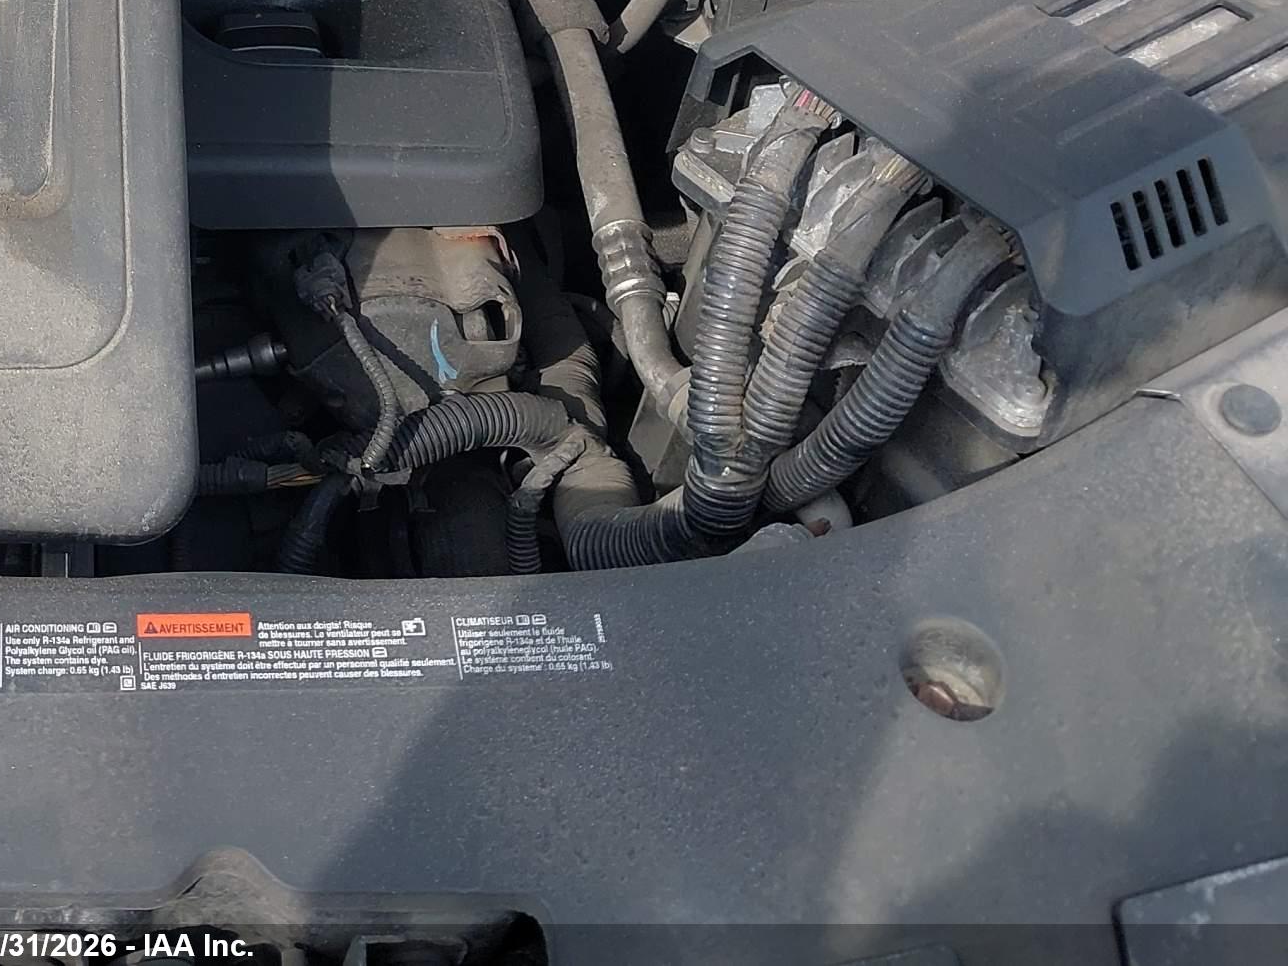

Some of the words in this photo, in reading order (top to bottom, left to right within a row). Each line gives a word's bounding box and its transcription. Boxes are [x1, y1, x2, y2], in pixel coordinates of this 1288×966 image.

[258, 621, 295, 630] Attention
[343, 620, 372, 631] Risque
[456, 617, 513, 626] CLIMATISEUR
[5, 625, 20, 633] AIR
[22, 624, 84, 633] CONDITIONING
[160, 623, 244, 634] AVERTISSEMENT
[258, 630, 268, 638] de
[271, 629, 313, 638] blessures.
[326, 629, 369, 637] ventilateur
[371, 628, 390, 638] peut
[488, 628, 530, 636] seulement
[5, 636, 21, 644] Use
[22, 636, 40, 646] only
[43, 636, 70, 644] R-134a
[73, 636, 118, 646] Refrigerant
[119, 636, 134, 644] and
[259, 639, 286, 647] mettre
[294, 638, 324, 647] tourner
[348, 637, 407, 646] avertissement.
[5, 646, 56, 656] Polyalkylene
[58, 646, 84, 656] Glycol
[99, 646, 120, 656] (PAG
[121, 645, 137, 655] oil).
[143, 652, 175, 661] FLUIDE
[238, 651, 266, 659] R-134a
[268, 650, 292, 659] SOUS
[294, 650, 323, 658] HAUTE
[325, 649, 370, 658] PRESSION
[5, 656, 20, 664] The
[22, 656, 52, 666] system
[54, 656, 89, 664] contains
[91, 656, 108, 666] dye.
[546, 653, 557, 661] du
[237, 661, 253, 669] doit
[308, 661, 321, 670] par
[336, 659, 378, 669] personnel
[412, 657, 456, 666] seulement.
[5, 666, 36, 676] System
[37, 666, 68, 676] charge:
[70, 666, 87, 674] 0.65
[122, 666, 134, 675] lb)
[144, 673, 160, 681] Des
[251, 670, 297, 679] incorrectes
[299, 670, 332, 680] peuvent
[363, 669, 379, 677] des
[381, 668, 424, 677] blessures.
[464, 665, 493, 675] Charge
[141, 682, 157, 690] SAE
